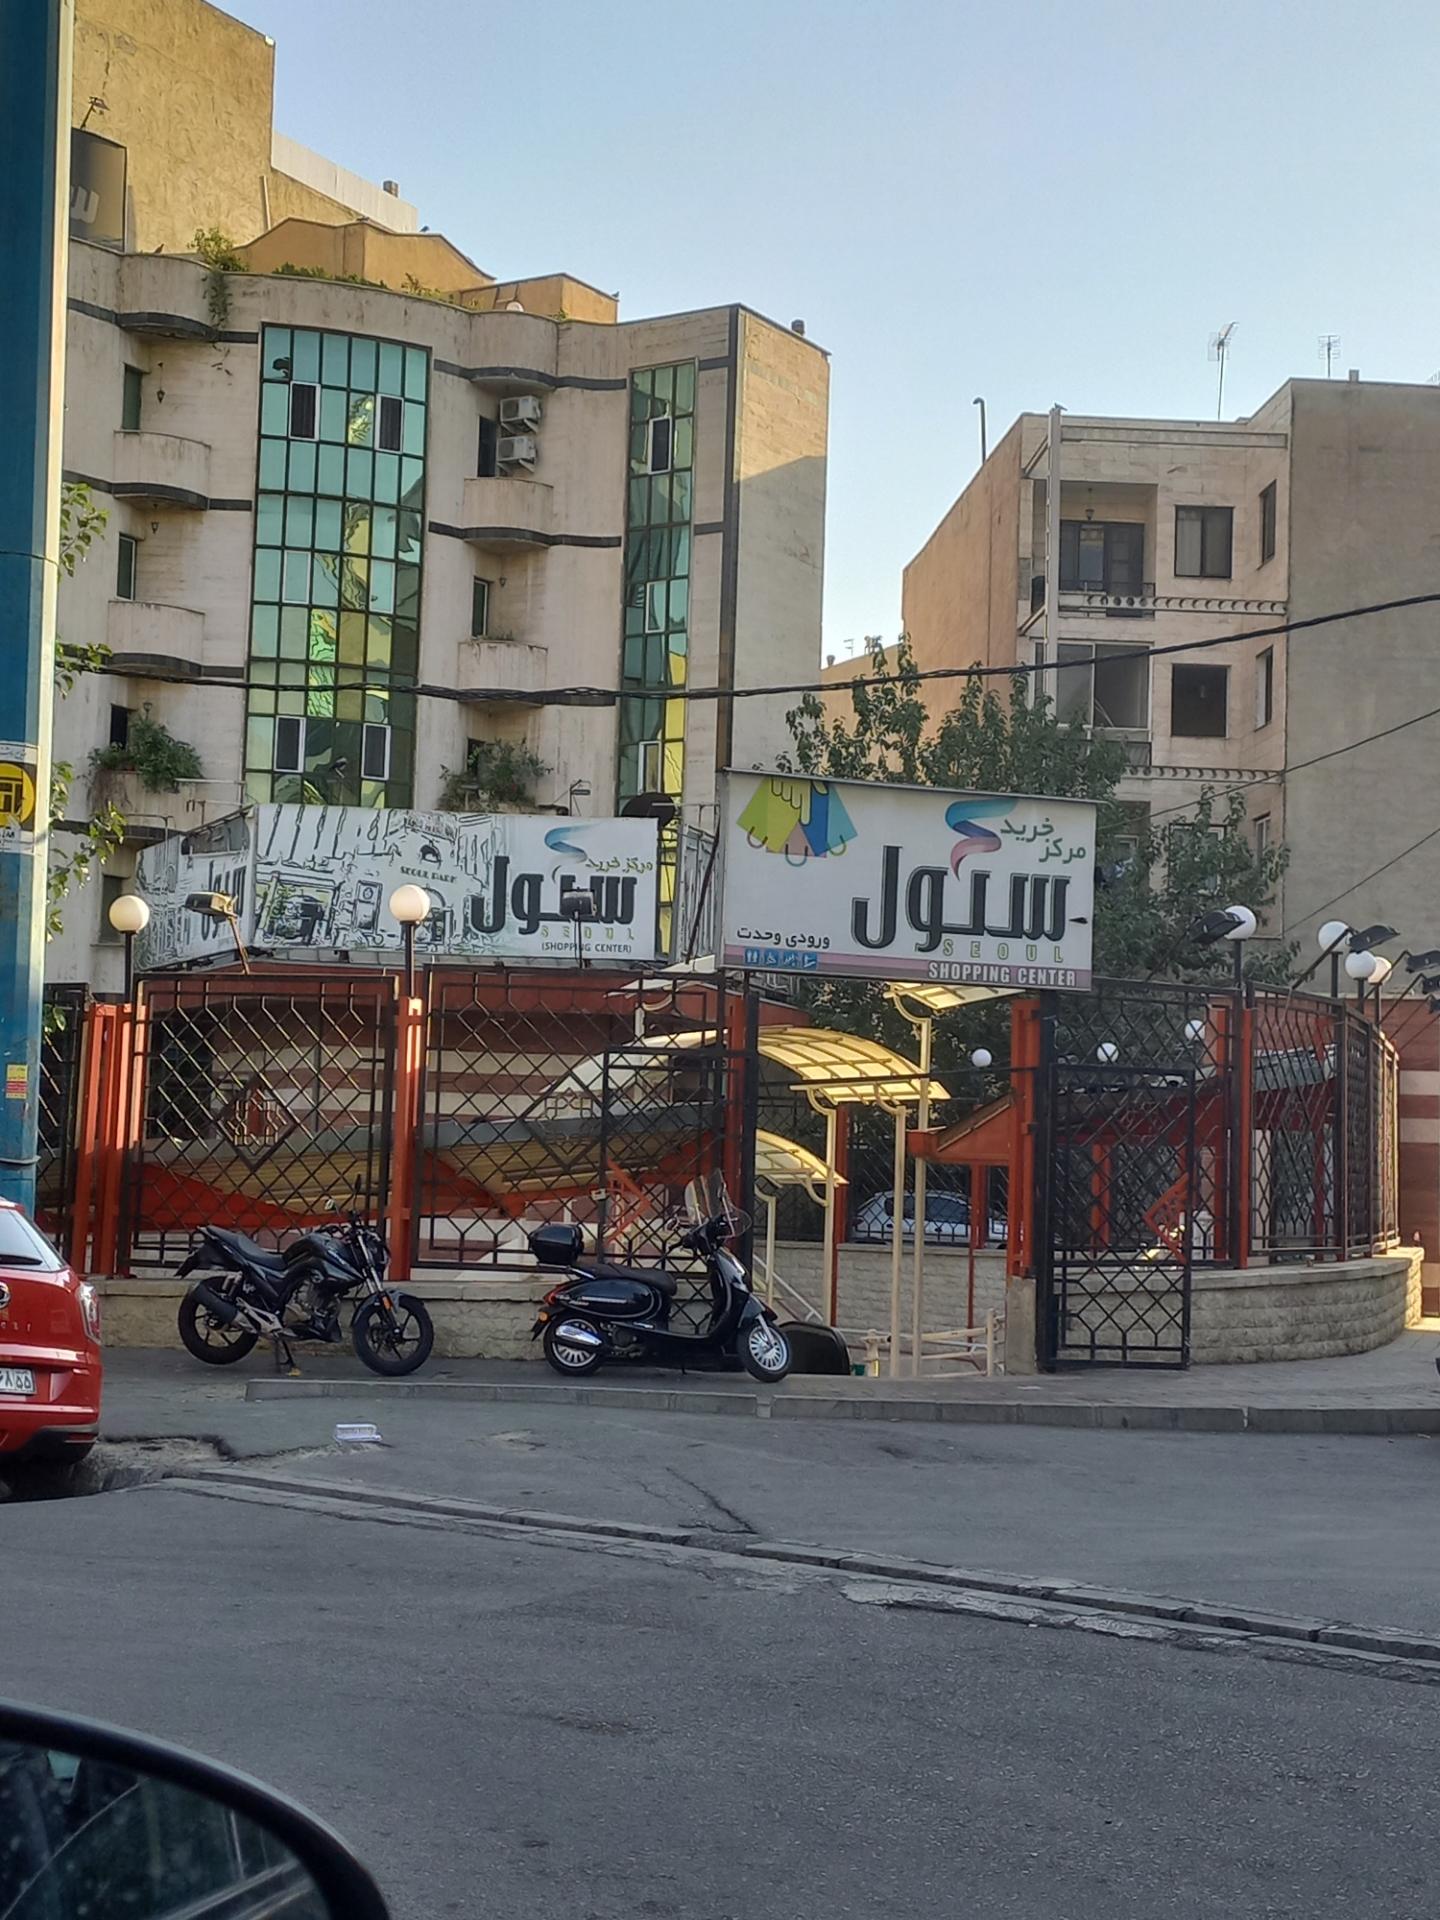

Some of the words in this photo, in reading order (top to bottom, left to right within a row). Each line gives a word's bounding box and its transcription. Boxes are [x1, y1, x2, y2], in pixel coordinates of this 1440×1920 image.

[1000, 817, 1056, 842] خرید
[1038, 837, 1086, 864] مرکز
[736, 927, 782, 945] وحدت
[785, 932, 831, 949] ورودی
[942, 940, 1064, 963] SEOUL
[928, 961, 1011, 984] SHOPPING
[1016, 967, 1076, 987] CENTER
